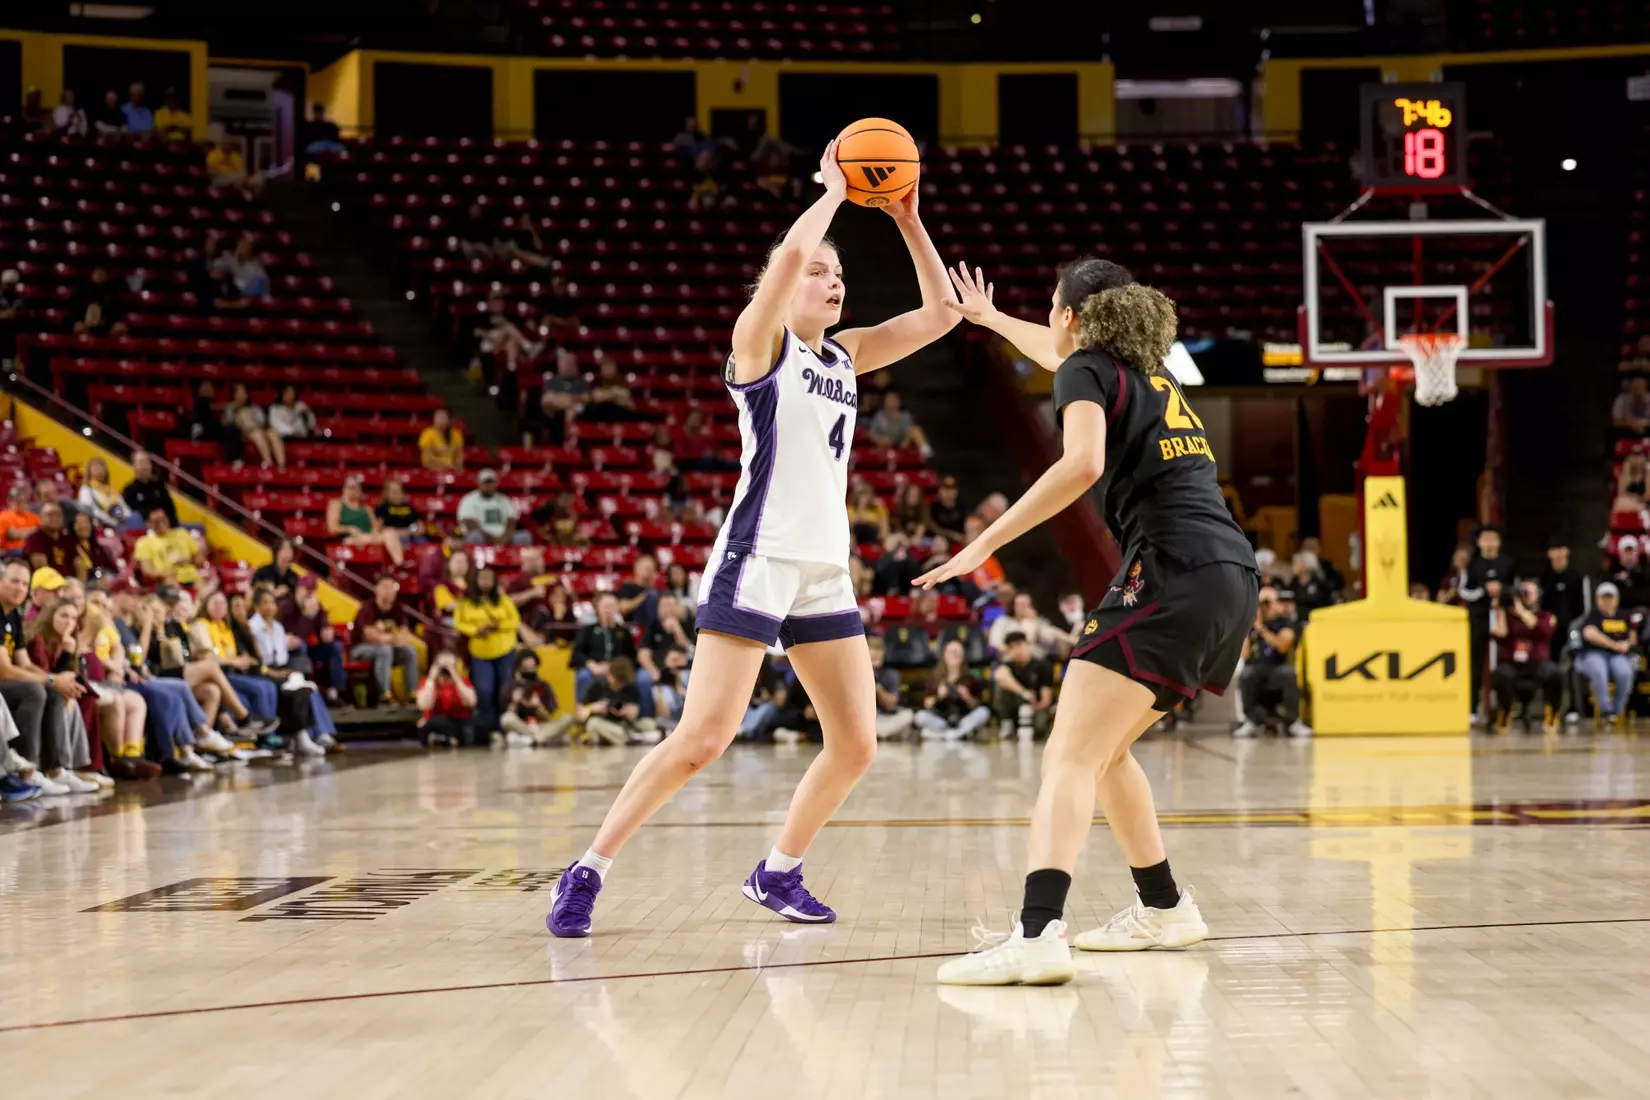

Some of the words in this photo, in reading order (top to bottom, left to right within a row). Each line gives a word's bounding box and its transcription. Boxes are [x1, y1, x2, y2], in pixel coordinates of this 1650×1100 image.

[1394, 97, 1452, 128] 7:46
[1404, 128, 1445, 179] 18
[828, 413, 847, 462] 4
[1325, 651, 1456, 680] KIA
